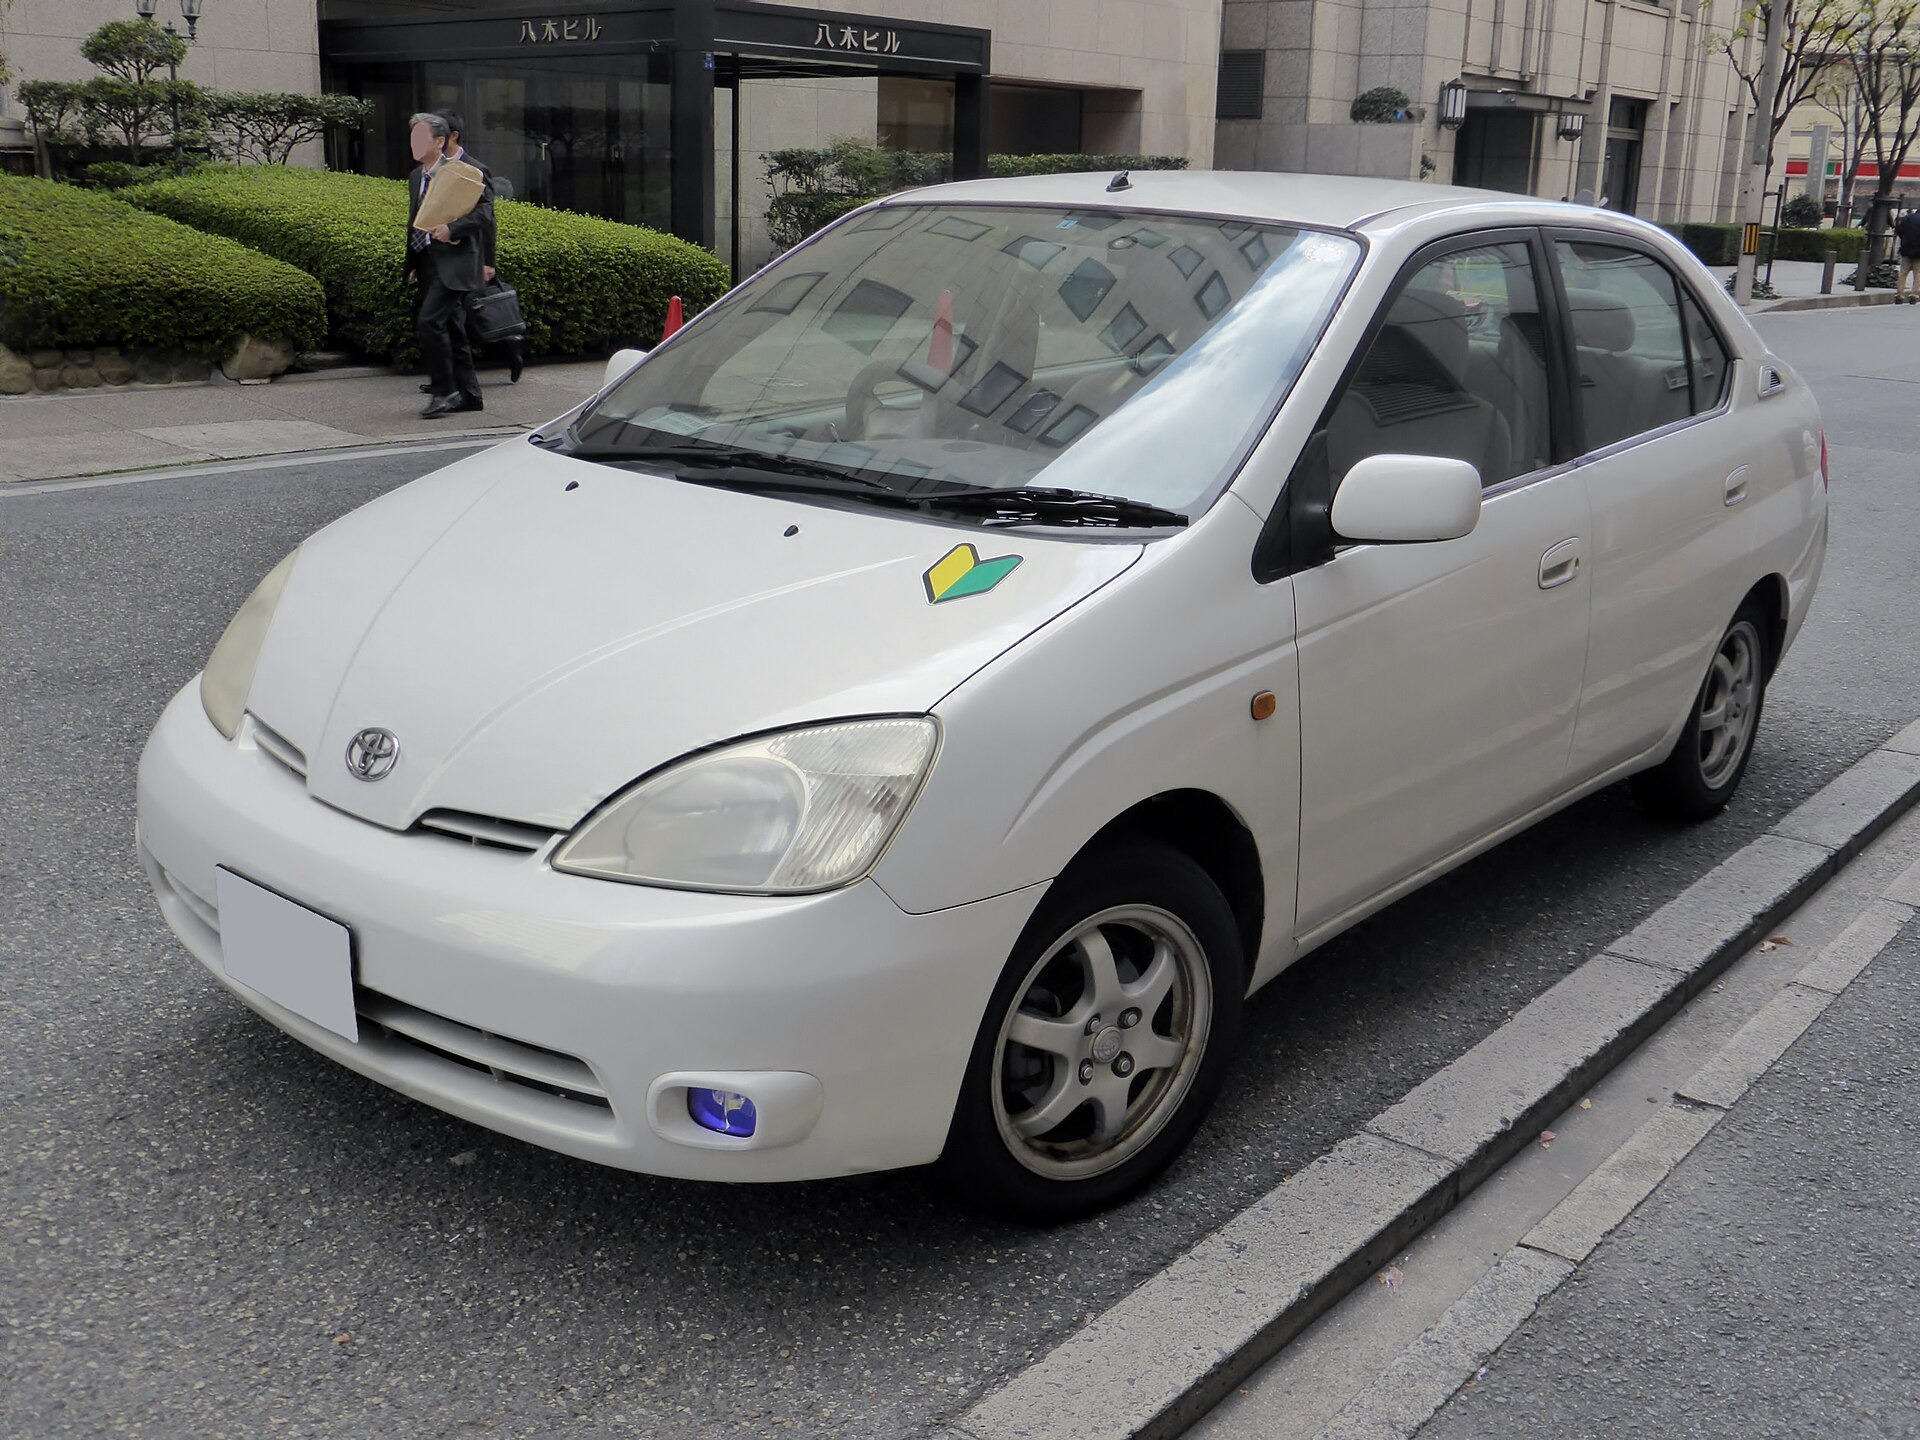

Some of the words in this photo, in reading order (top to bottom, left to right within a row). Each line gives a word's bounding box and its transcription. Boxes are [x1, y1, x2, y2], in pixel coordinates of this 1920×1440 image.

[519, 18, 602, 42] 八木ビル
[814, 23, 901, 53] 八木ビル
